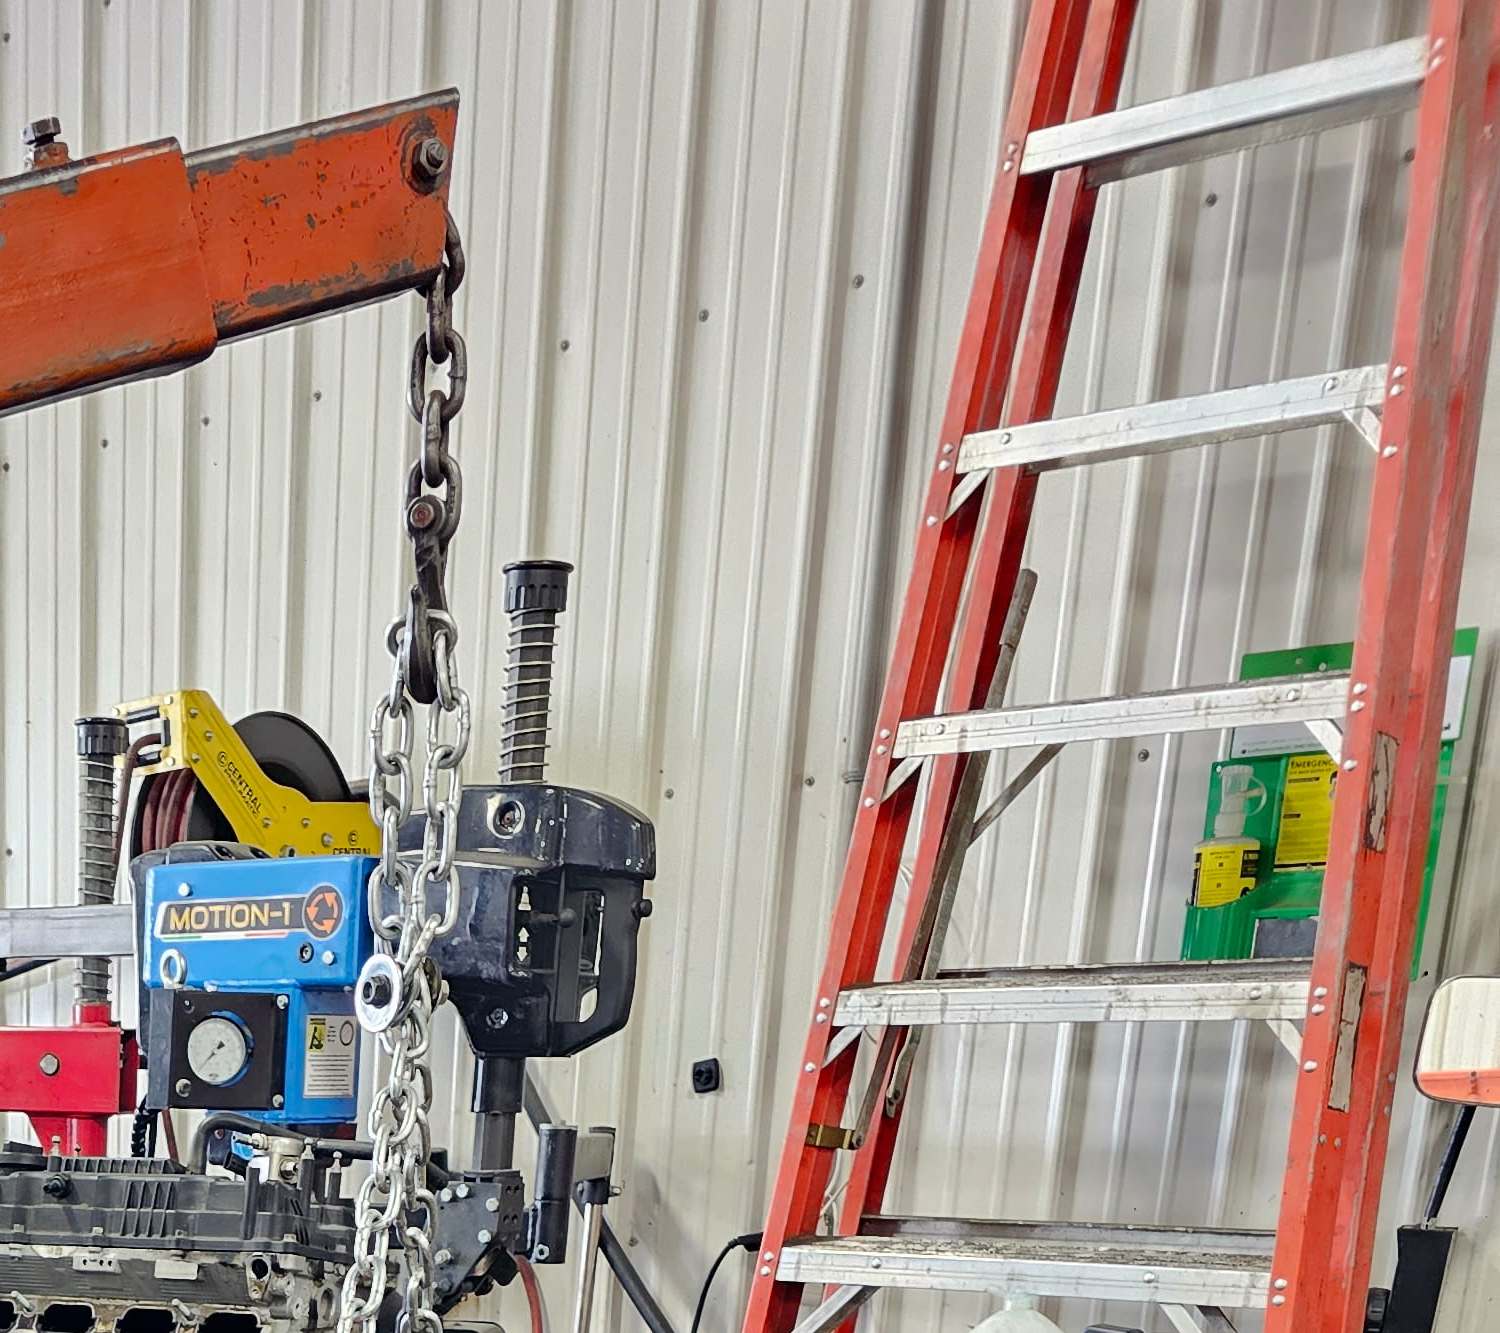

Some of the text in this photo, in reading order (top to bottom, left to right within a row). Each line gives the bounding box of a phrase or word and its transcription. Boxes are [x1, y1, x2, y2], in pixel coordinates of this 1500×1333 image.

[1291, 759, 1334, 769] EMERGENC
[227, 761, 261, 813] CENTRAL
[170, 902, 291, 930] MOTION-1
